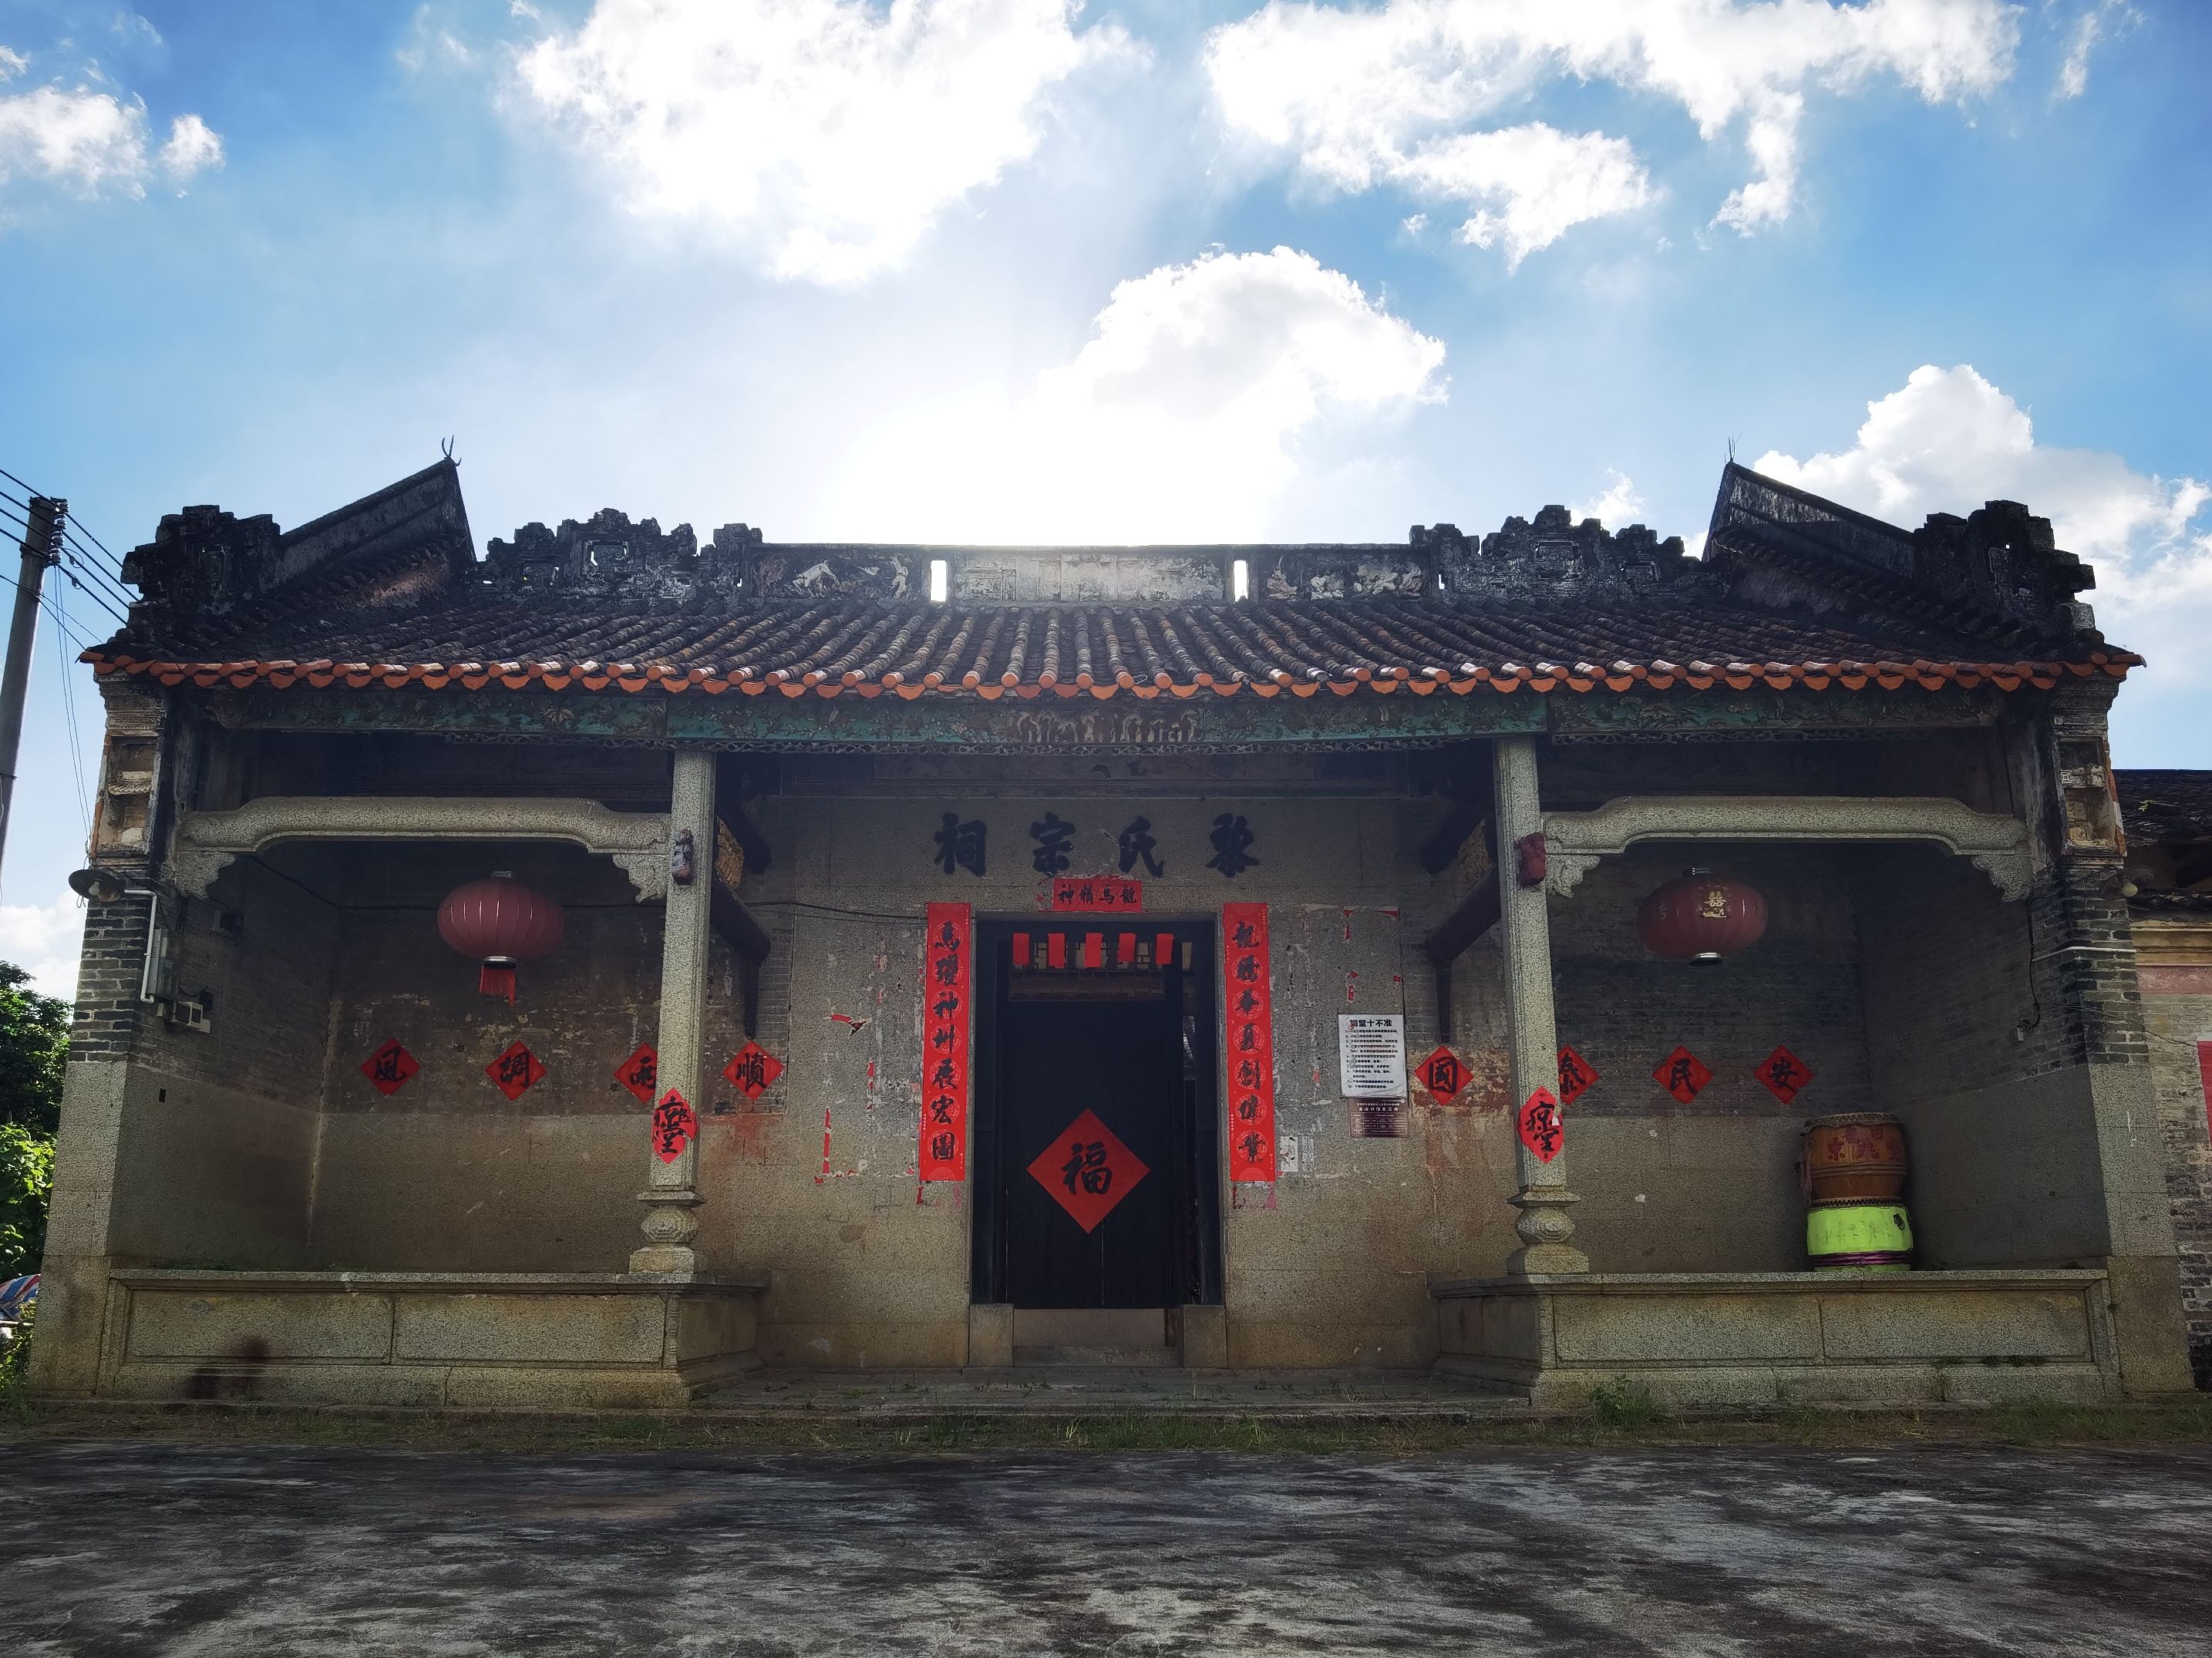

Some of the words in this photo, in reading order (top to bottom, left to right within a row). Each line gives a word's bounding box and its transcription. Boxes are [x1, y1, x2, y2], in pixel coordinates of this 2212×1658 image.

[1058, 884, 1136, 905] 龍馬精神
[500, 1051, 530, 1088] 調
[736, 1052, 767, 1091] 順
[1429, 1056, 1458, 1094] 國
[1558, 1052, 1586, 1094] 泰
[1670, 1058, 1698, 1095] 民
[1769, 1055, 1800, 1094] 安
[1061, 1141, 1113, 1196] 福
